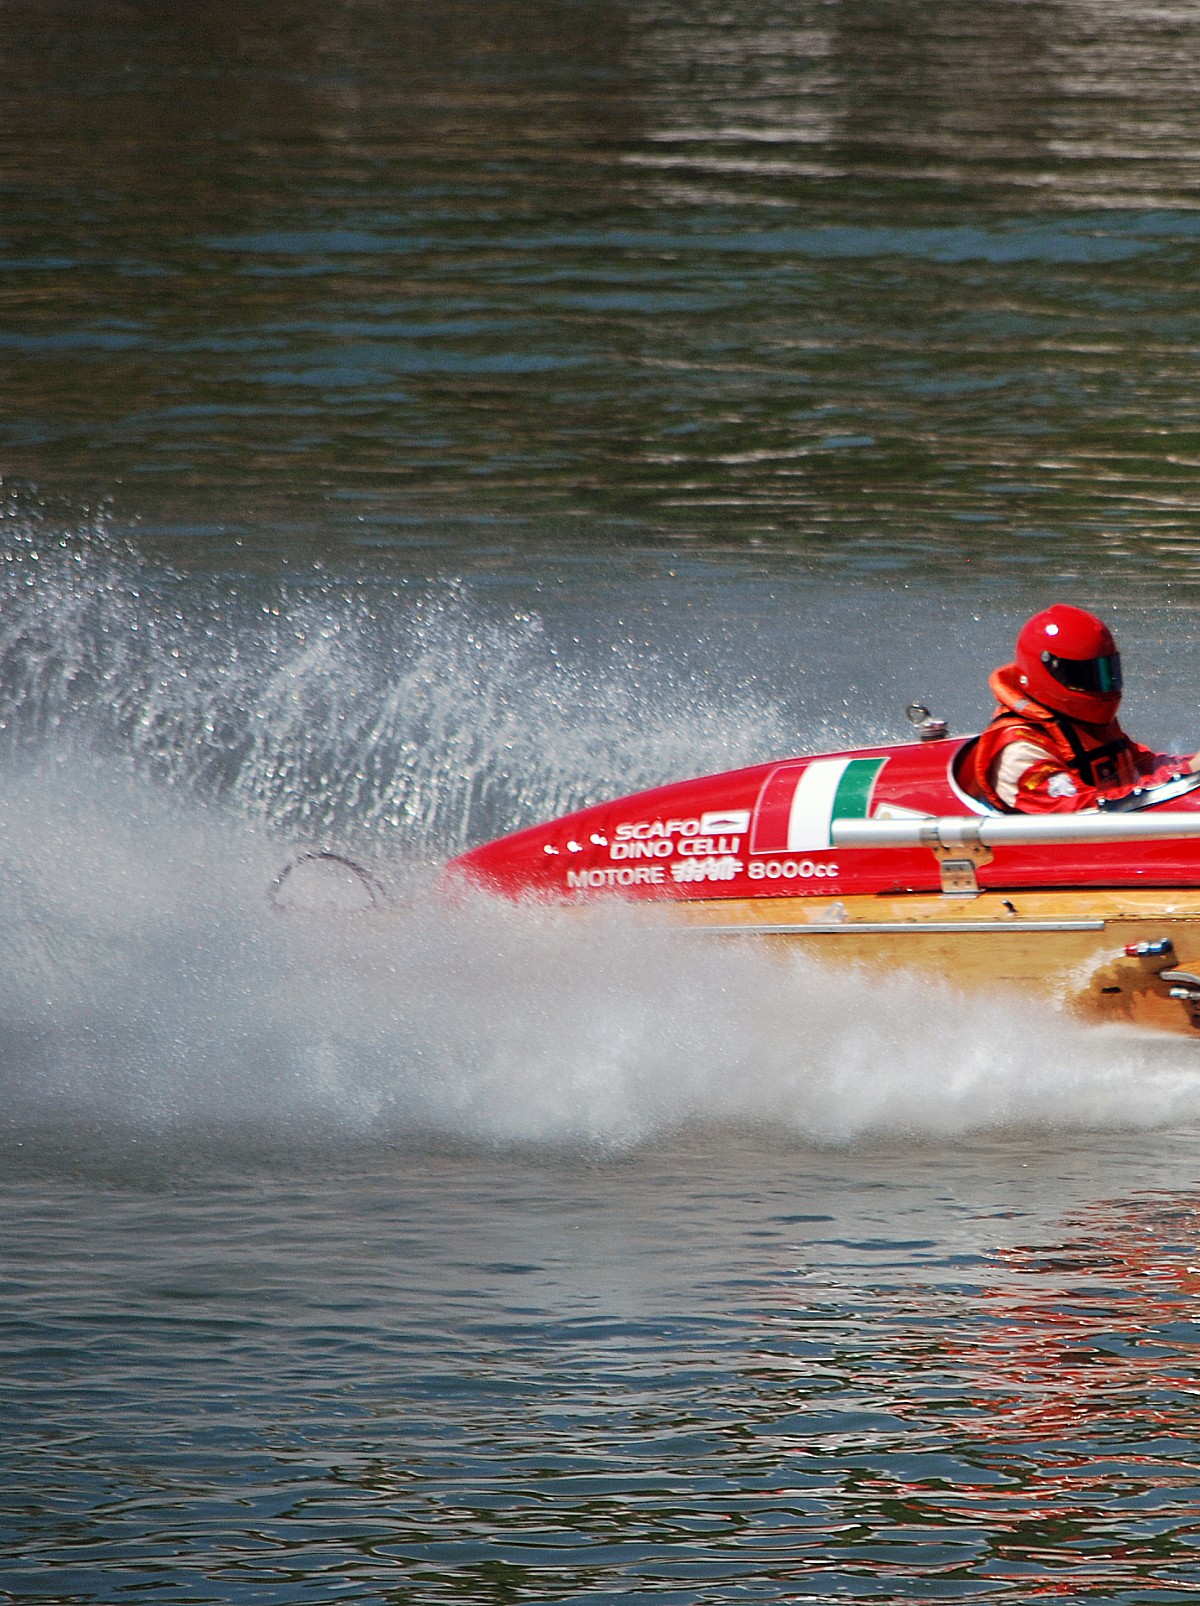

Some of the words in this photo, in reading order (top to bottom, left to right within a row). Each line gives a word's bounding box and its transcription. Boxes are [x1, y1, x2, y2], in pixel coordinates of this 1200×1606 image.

[615, 822, 700, 840] SCAFO
[611, 840, 673, 860] DINO
[677, 838, 739, 855] CELLI
[567, 868, 664, 888] MOTORE
[748, 861, 839, 880] 8000cc
